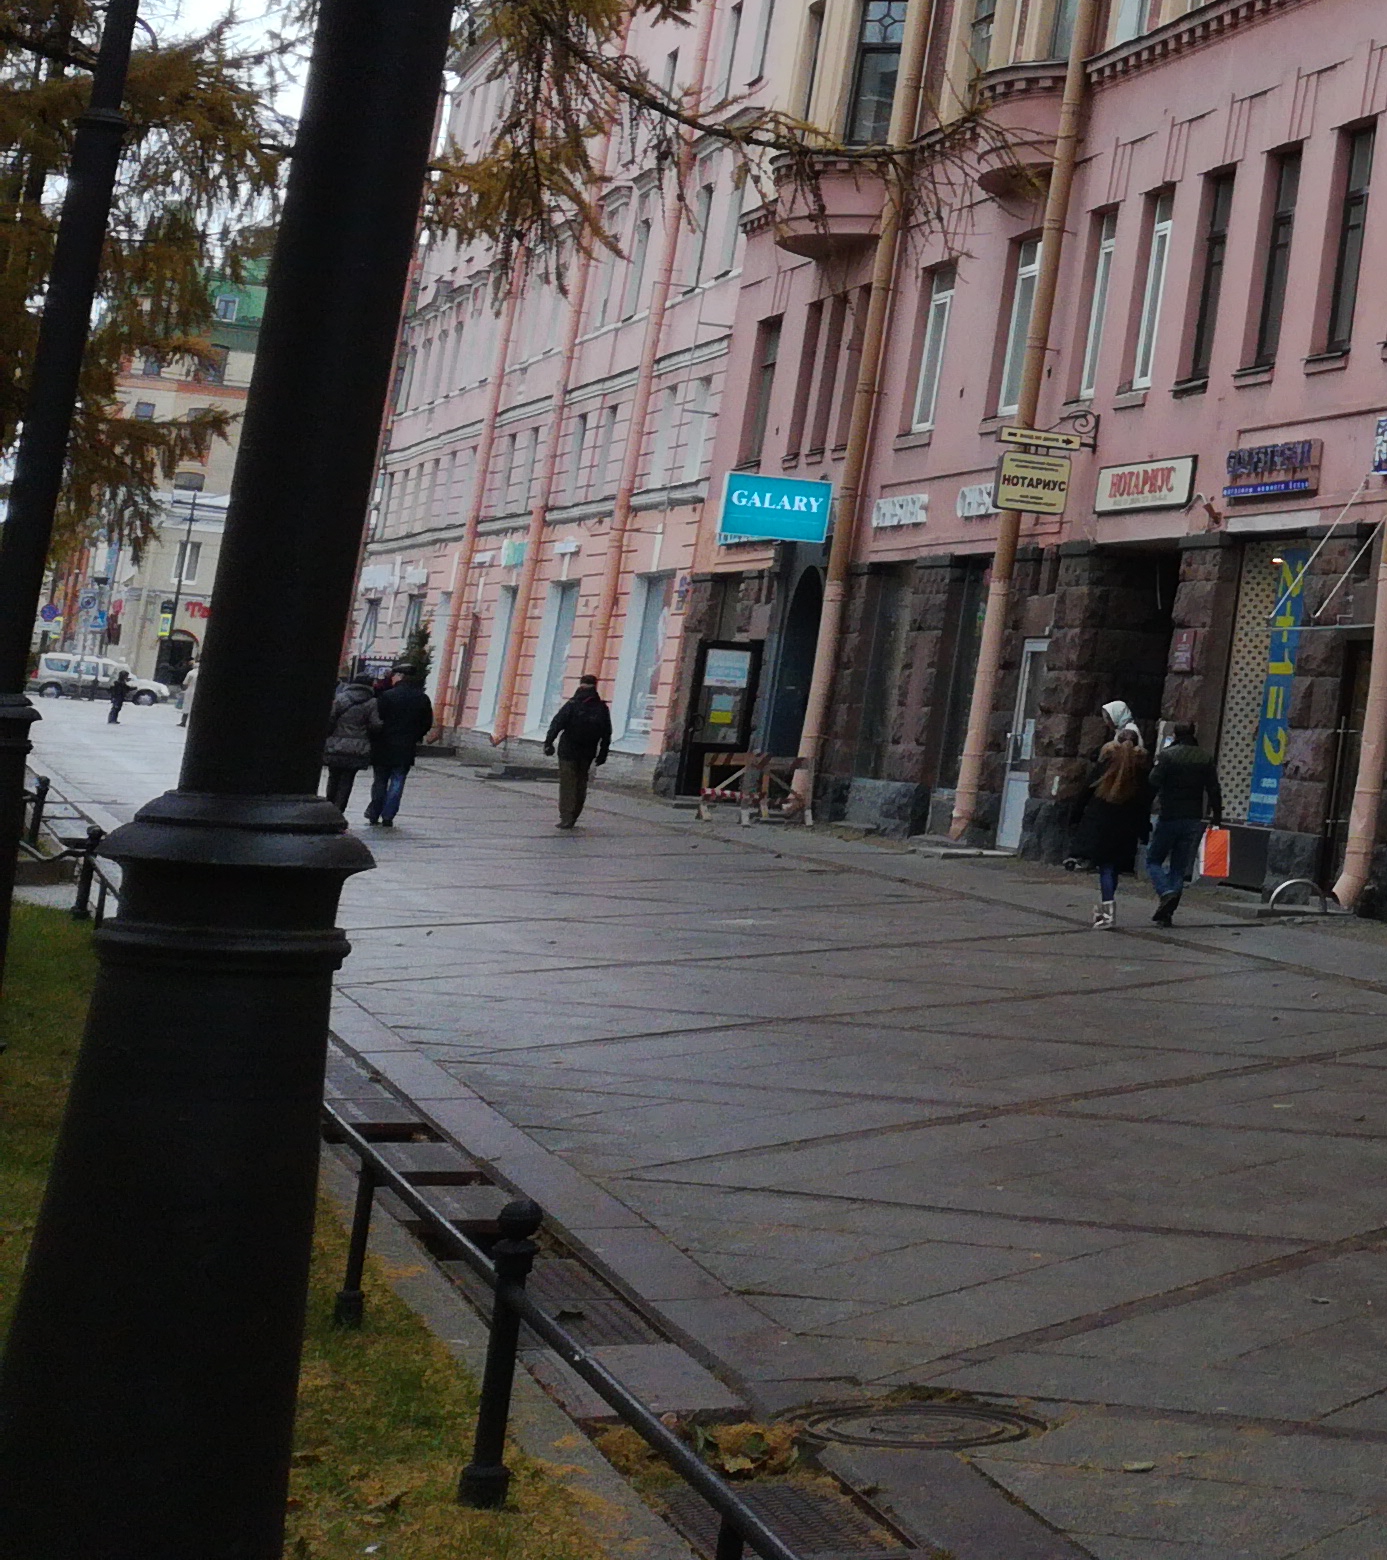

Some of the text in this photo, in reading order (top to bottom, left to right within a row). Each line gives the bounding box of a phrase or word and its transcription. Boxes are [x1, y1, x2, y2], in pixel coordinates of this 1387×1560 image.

[1002, 473, 1067, 492] НОТАРИУС
[1108, 466, 1177, 499] НОТАРИУС
[731, 489, 824, 513] GALARY
